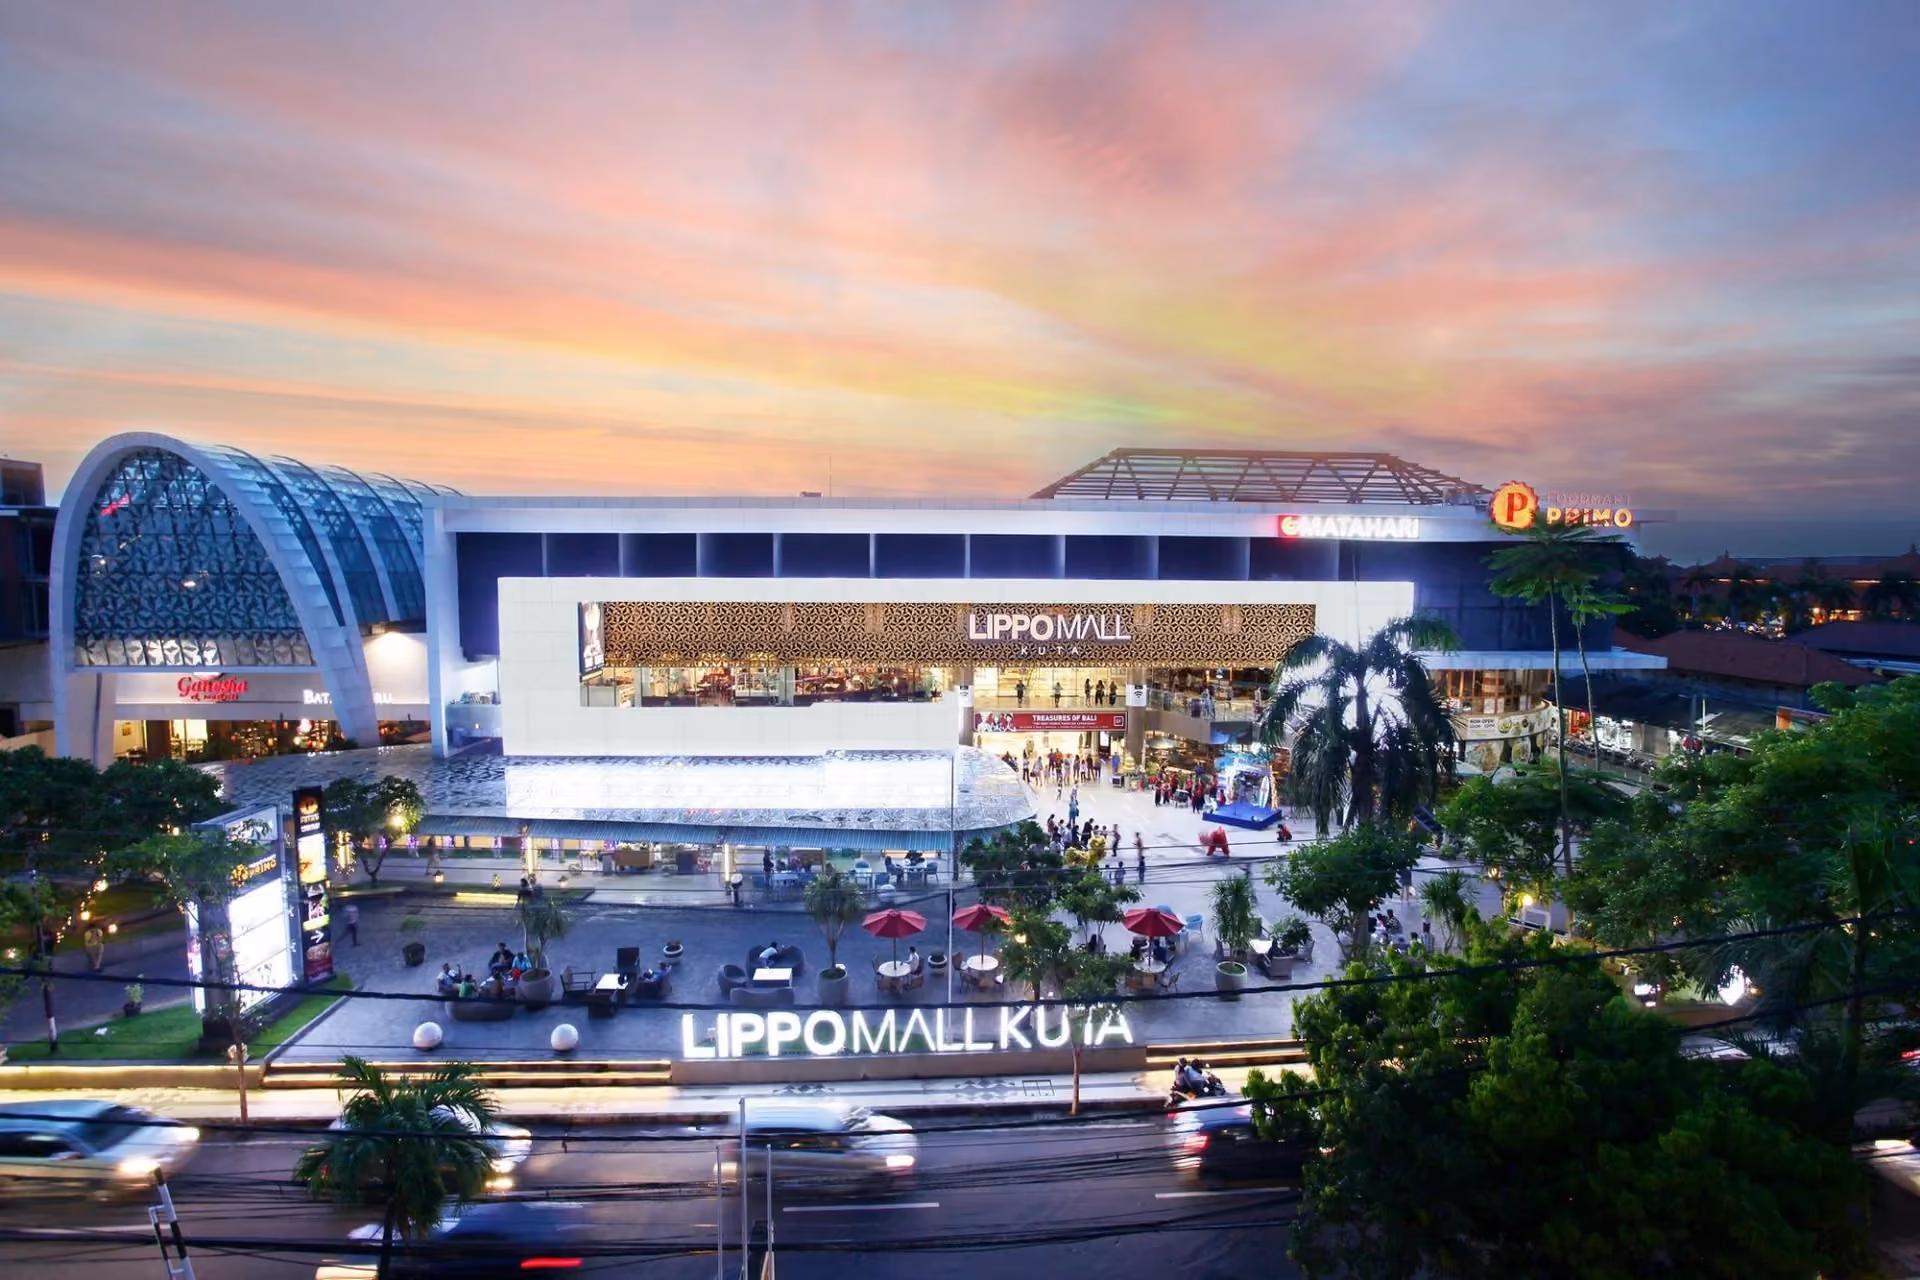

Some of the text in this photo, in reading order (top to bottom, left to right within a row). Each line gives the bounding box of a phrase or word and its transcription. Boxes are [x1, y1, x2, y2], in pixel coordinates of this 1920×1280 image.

[1301, 515, 1419, 539] MATAHARI
[1546, 507, 1633, 528] PRIMO
[1021, 646, 1079, 656] KUTA
[177, 676, 248, 697] Ganesha
